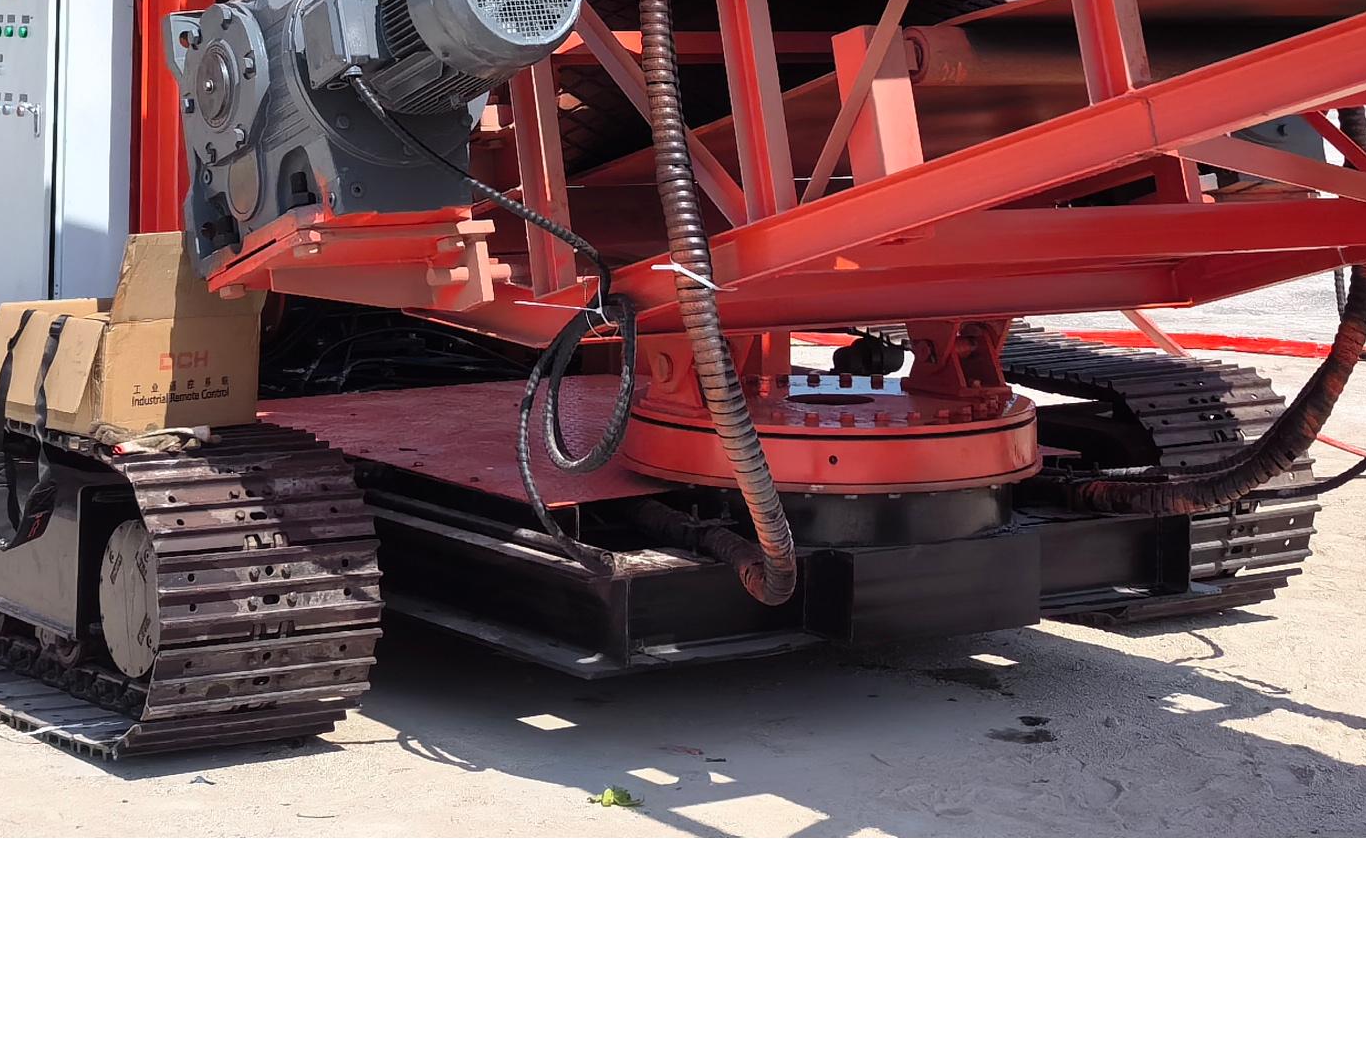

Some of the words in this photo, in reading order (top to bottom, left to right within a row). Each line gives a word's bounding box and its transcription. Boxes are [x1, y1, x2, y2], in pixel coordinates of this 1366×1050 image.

[131, 392, 168, 407] Industrial
[169, 391, 200, 403] Remote
[201, 386, 230, 400] Control
